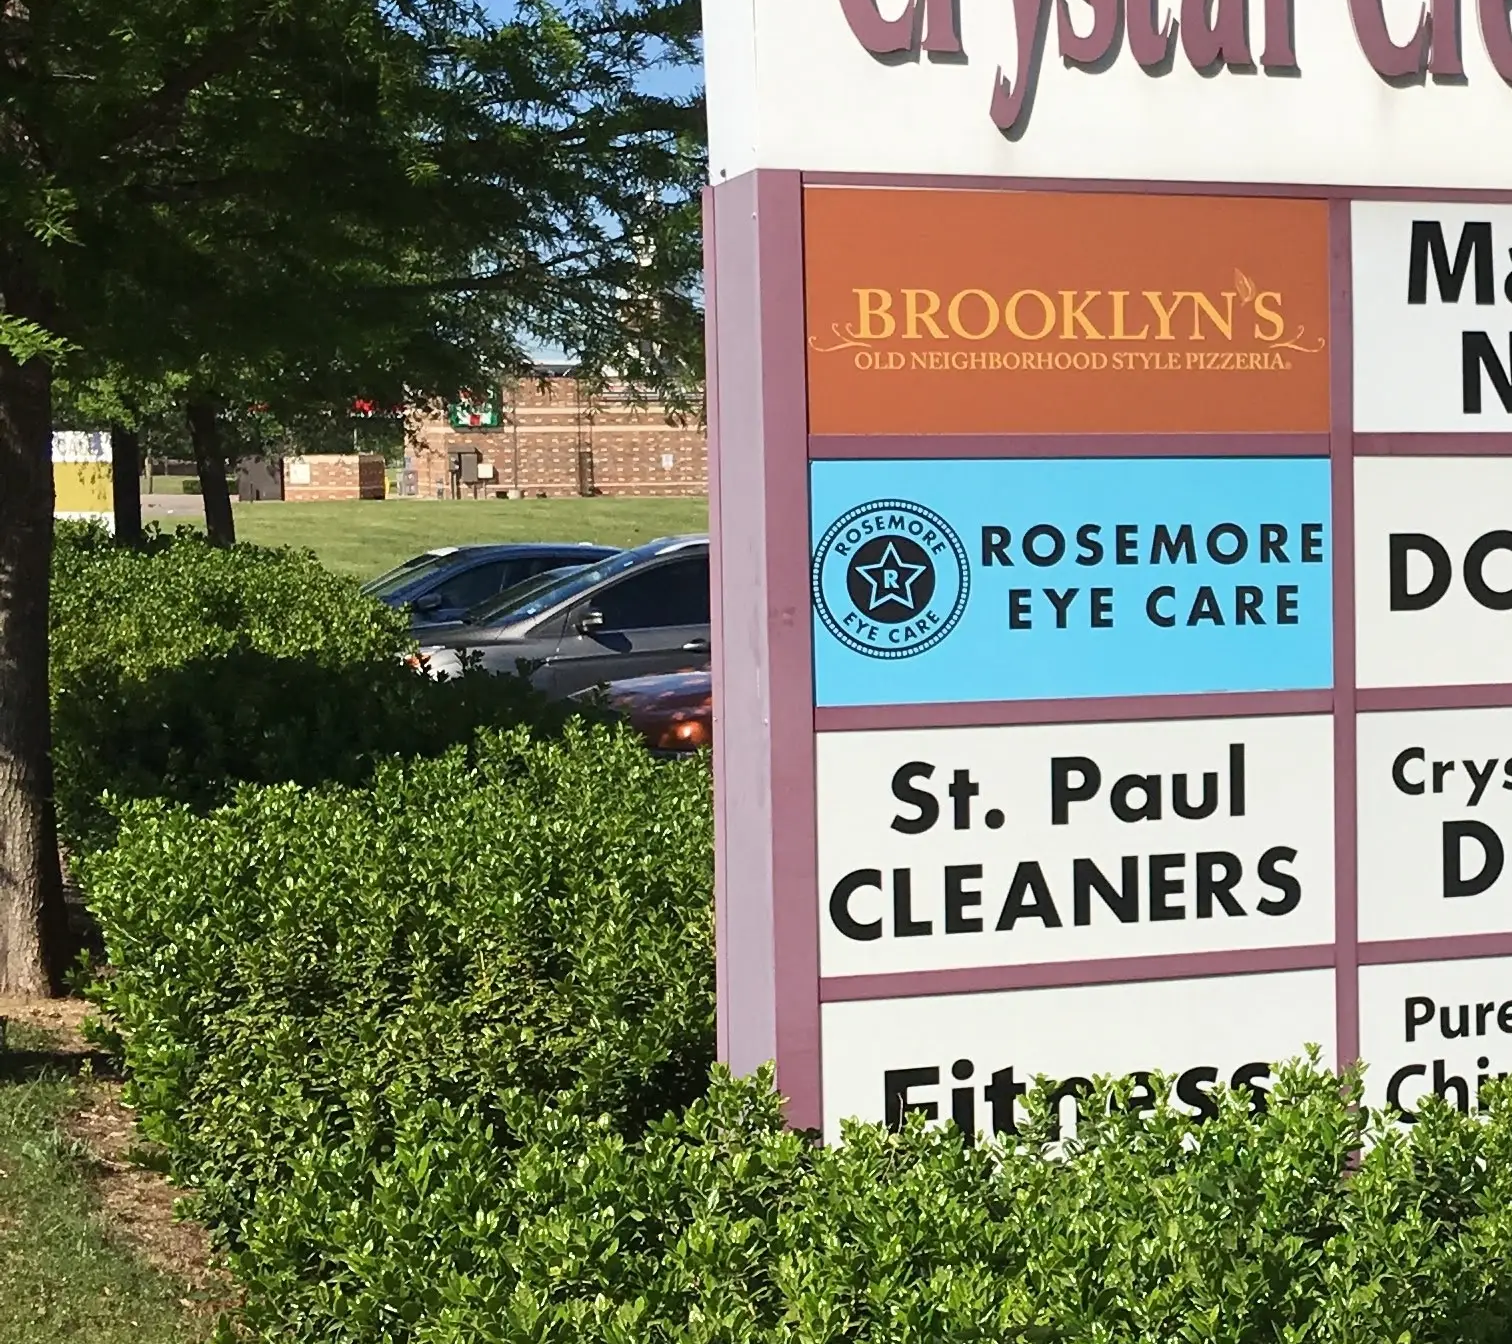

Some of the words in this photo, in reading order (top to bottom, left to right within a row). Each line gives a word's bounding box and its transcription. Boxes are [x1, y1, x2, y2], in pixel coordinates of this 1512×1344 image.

[852, 270, 1284, 341] BROOKLYN'S
[855, 351, 905, 370] OLD
[910, 351, 1107, 370] NEIGHBORHOOD
[1112, 351, 1181, 370] STYLE
[835, 515, 947, 557] ROSEMORE
[981, 521, 1327, 569] ROSEMORE
[884, 569, 899, 589] R
[843, 612, 879, 642] EYE
[888, 610, 941, 644] CARE
[1008, 585, 1117, 632] EYE
[1146, 584, 1302, 629] CARE
[890, 761, 1006, 836] St.
[1052, 743, 1248, 827] Paul
[829, 844, 1303, 943] CLEANERS
